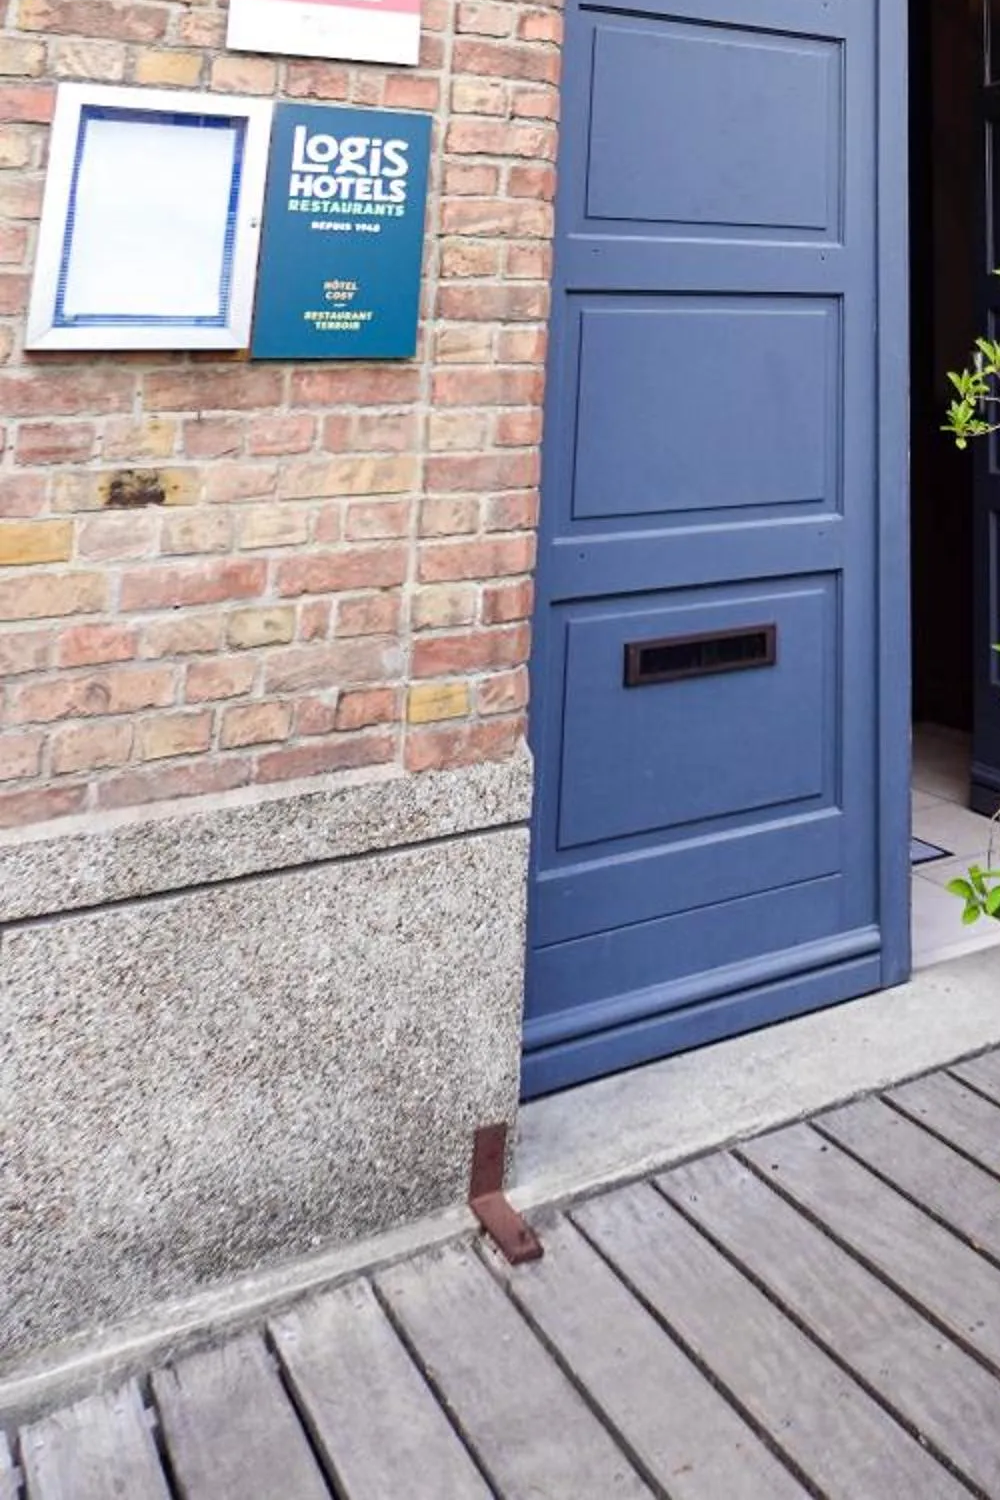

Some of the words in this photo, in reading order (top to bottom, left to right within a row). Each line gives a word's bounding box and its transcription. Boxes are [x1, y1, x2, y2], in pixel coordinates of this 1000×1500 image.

[289, 172, 407, 203] HOTELS
[288, 198, 405, 217] RESTAURANTS
[303, 311, 373, 321] RESTAURANT
